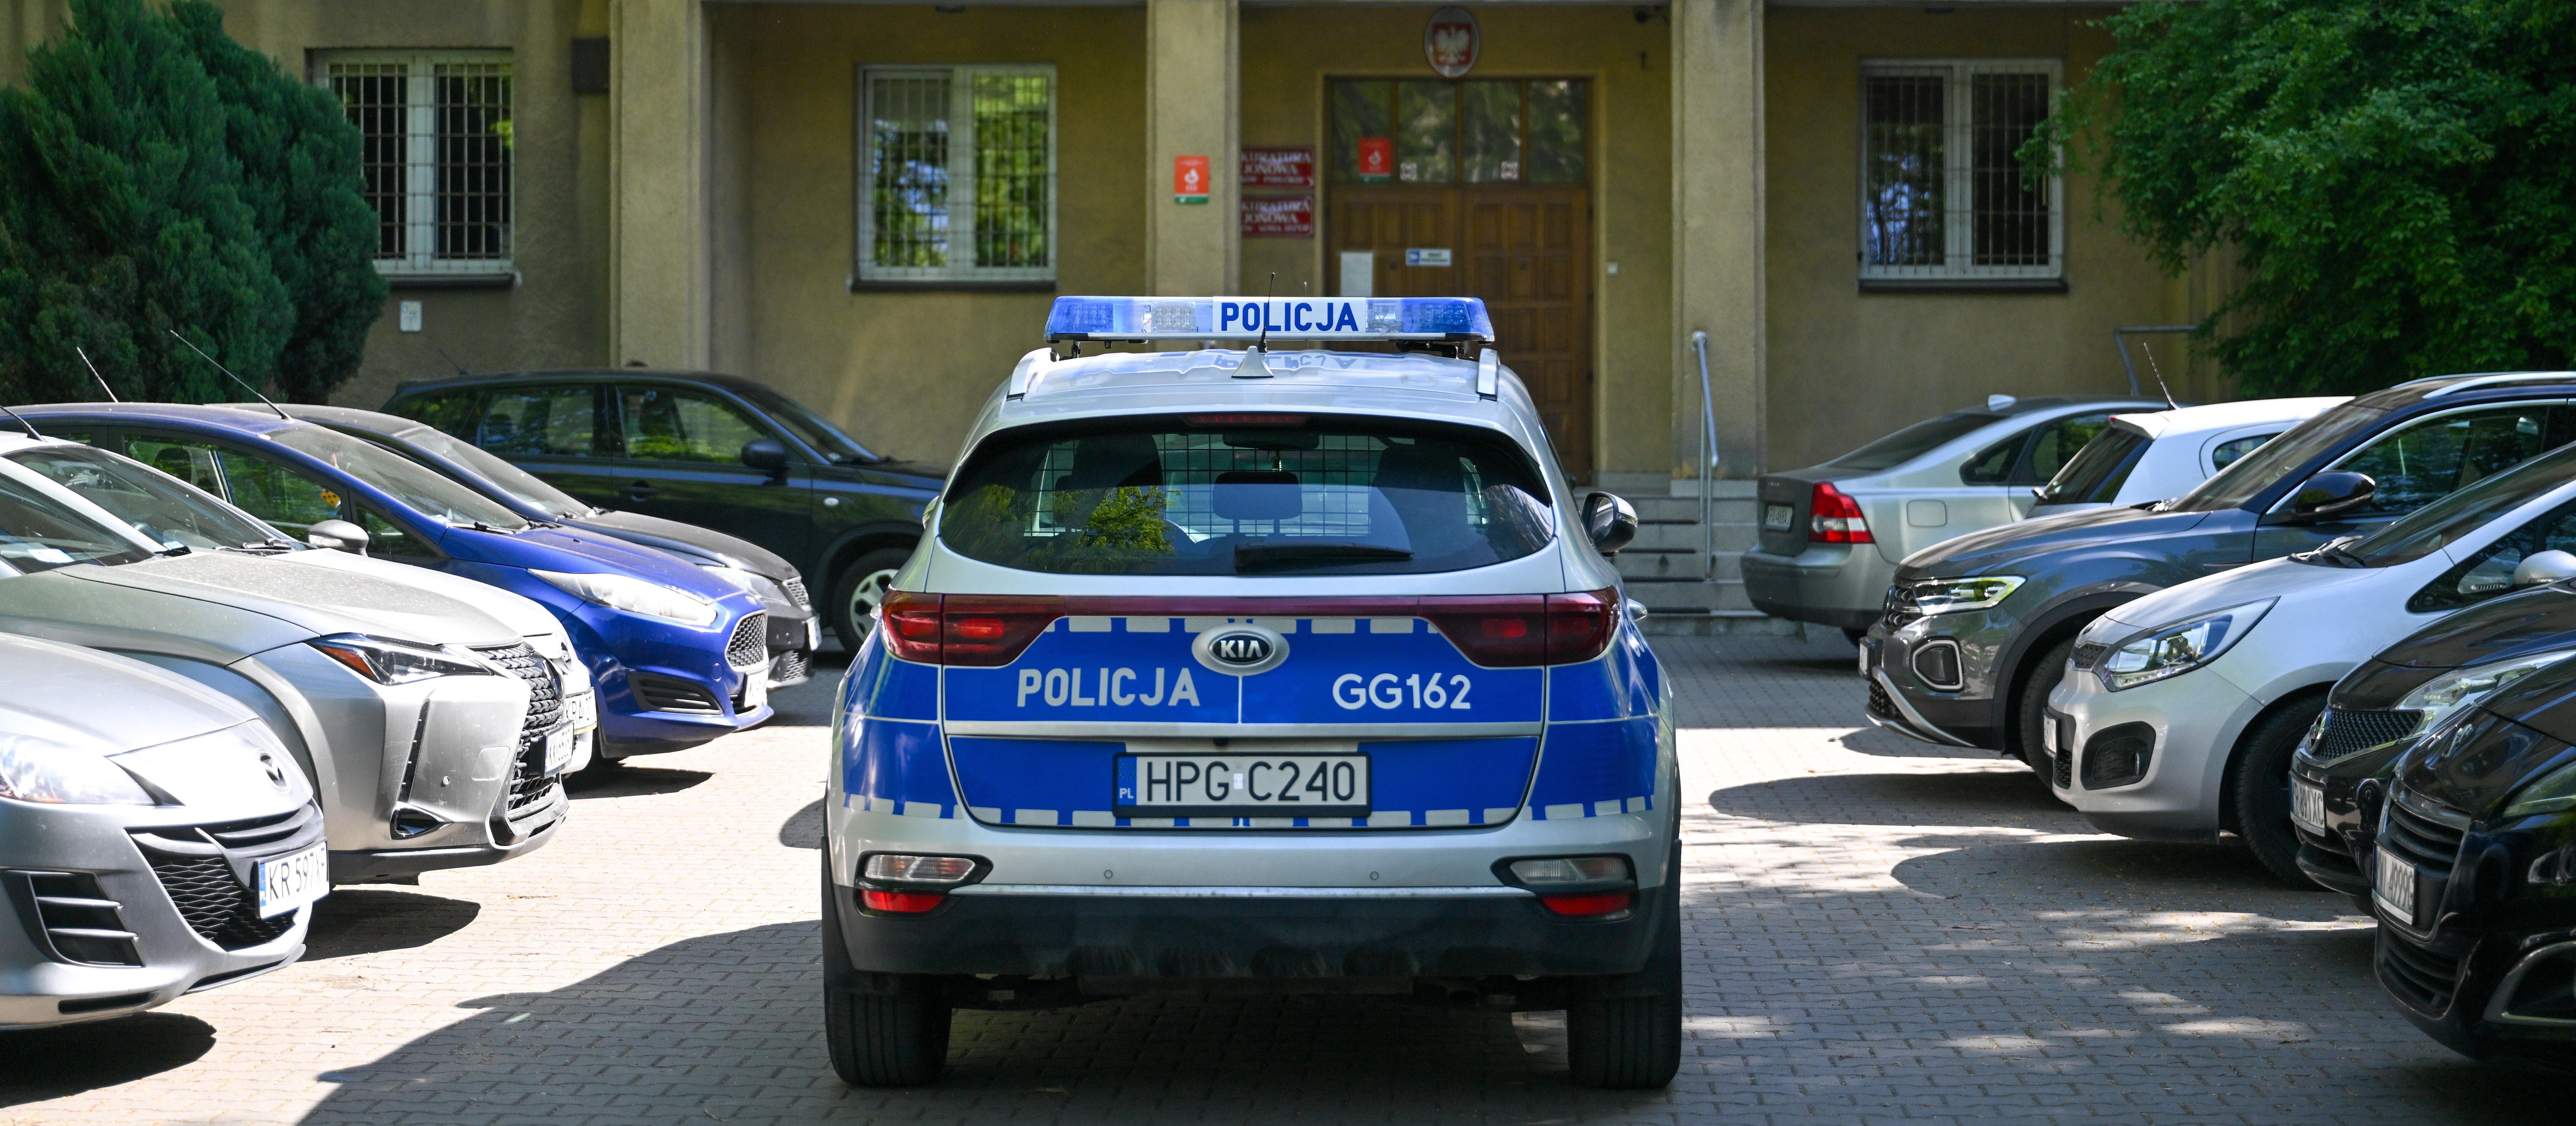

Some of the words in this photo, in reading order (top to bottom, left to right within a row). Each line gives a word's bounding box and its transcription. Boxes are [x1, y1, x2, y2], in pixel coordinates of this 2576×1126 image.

[1221, 302, 1359, 331] POLICJA
[1220, 640, 1263, 658] KIA
[1017, 667, 1201, 707] POLICJA
[1332, 673, 1471, 710] GG162
[1119, 787, 1134, 799] PL
[1147, 761, 1229, 801] HPG
[1248, 761, 1355, 801] C240
[269, 861, 290, 902] KR
